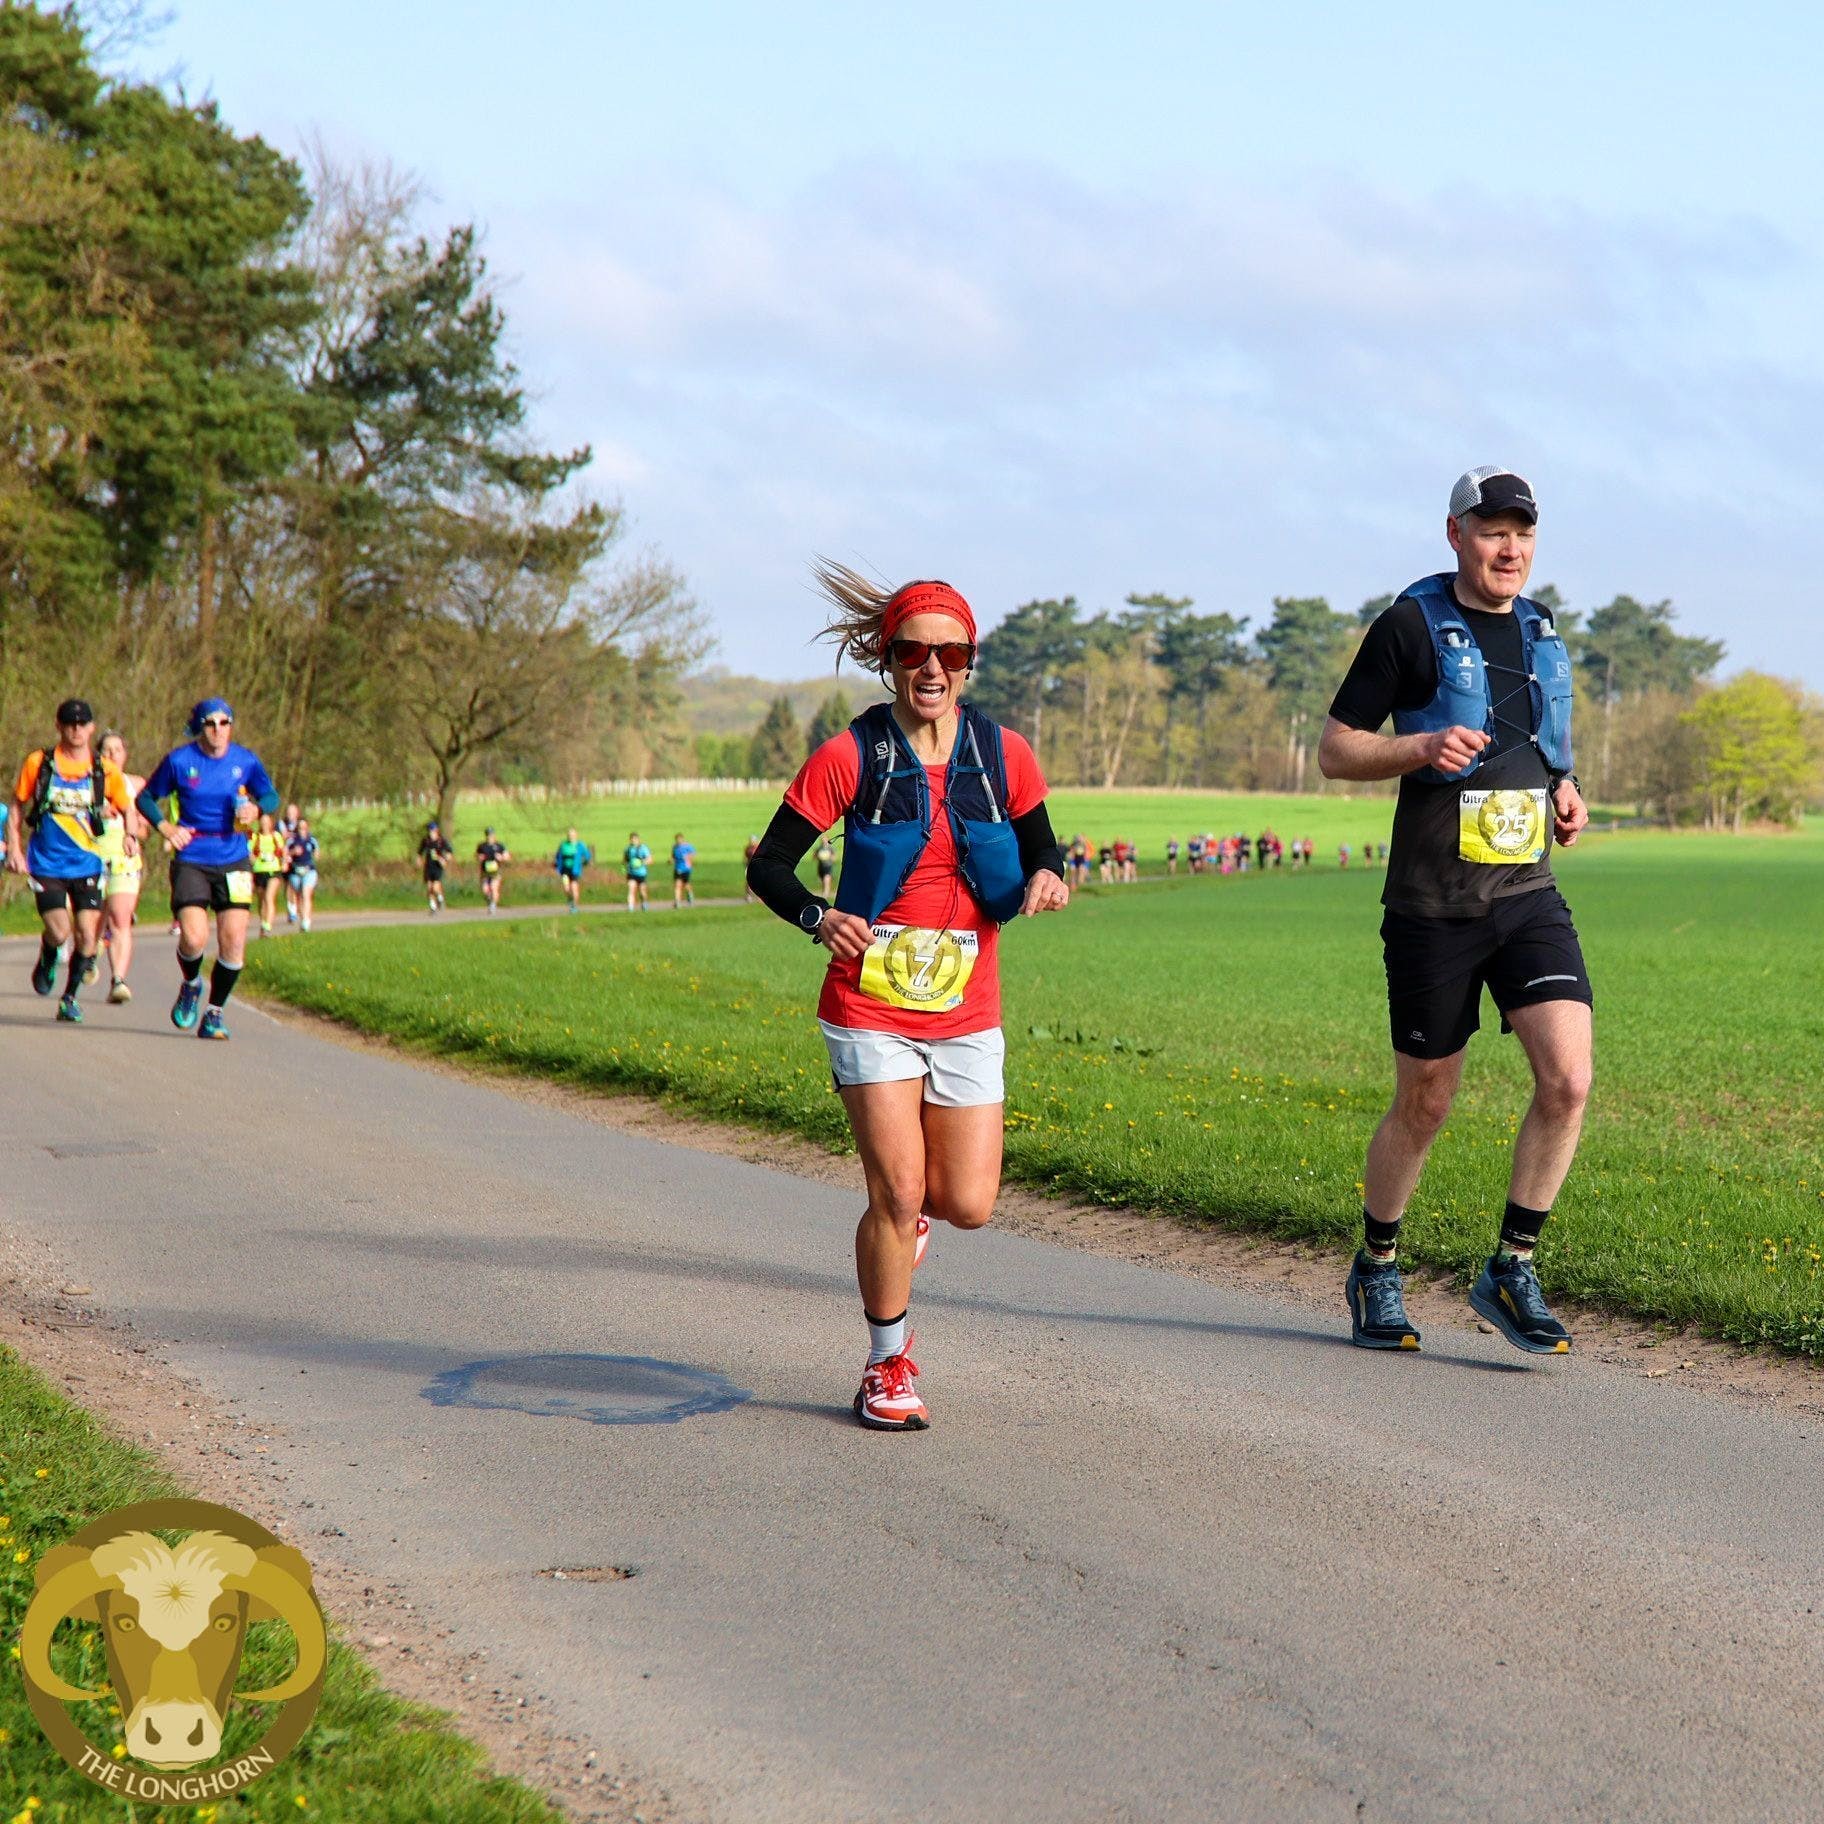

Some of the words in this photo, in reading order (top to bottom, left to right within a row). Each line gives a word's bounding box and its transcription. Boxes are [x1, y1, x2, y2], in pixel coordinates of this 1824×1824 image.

[1462, 794, 1488, 804] Ultra
[1493, 814, 1530, 844] 25
[872, 927, 899, 939] Ultra
[951, 936, 976, 946] 60km
[913, 955, 935, 987] 7
